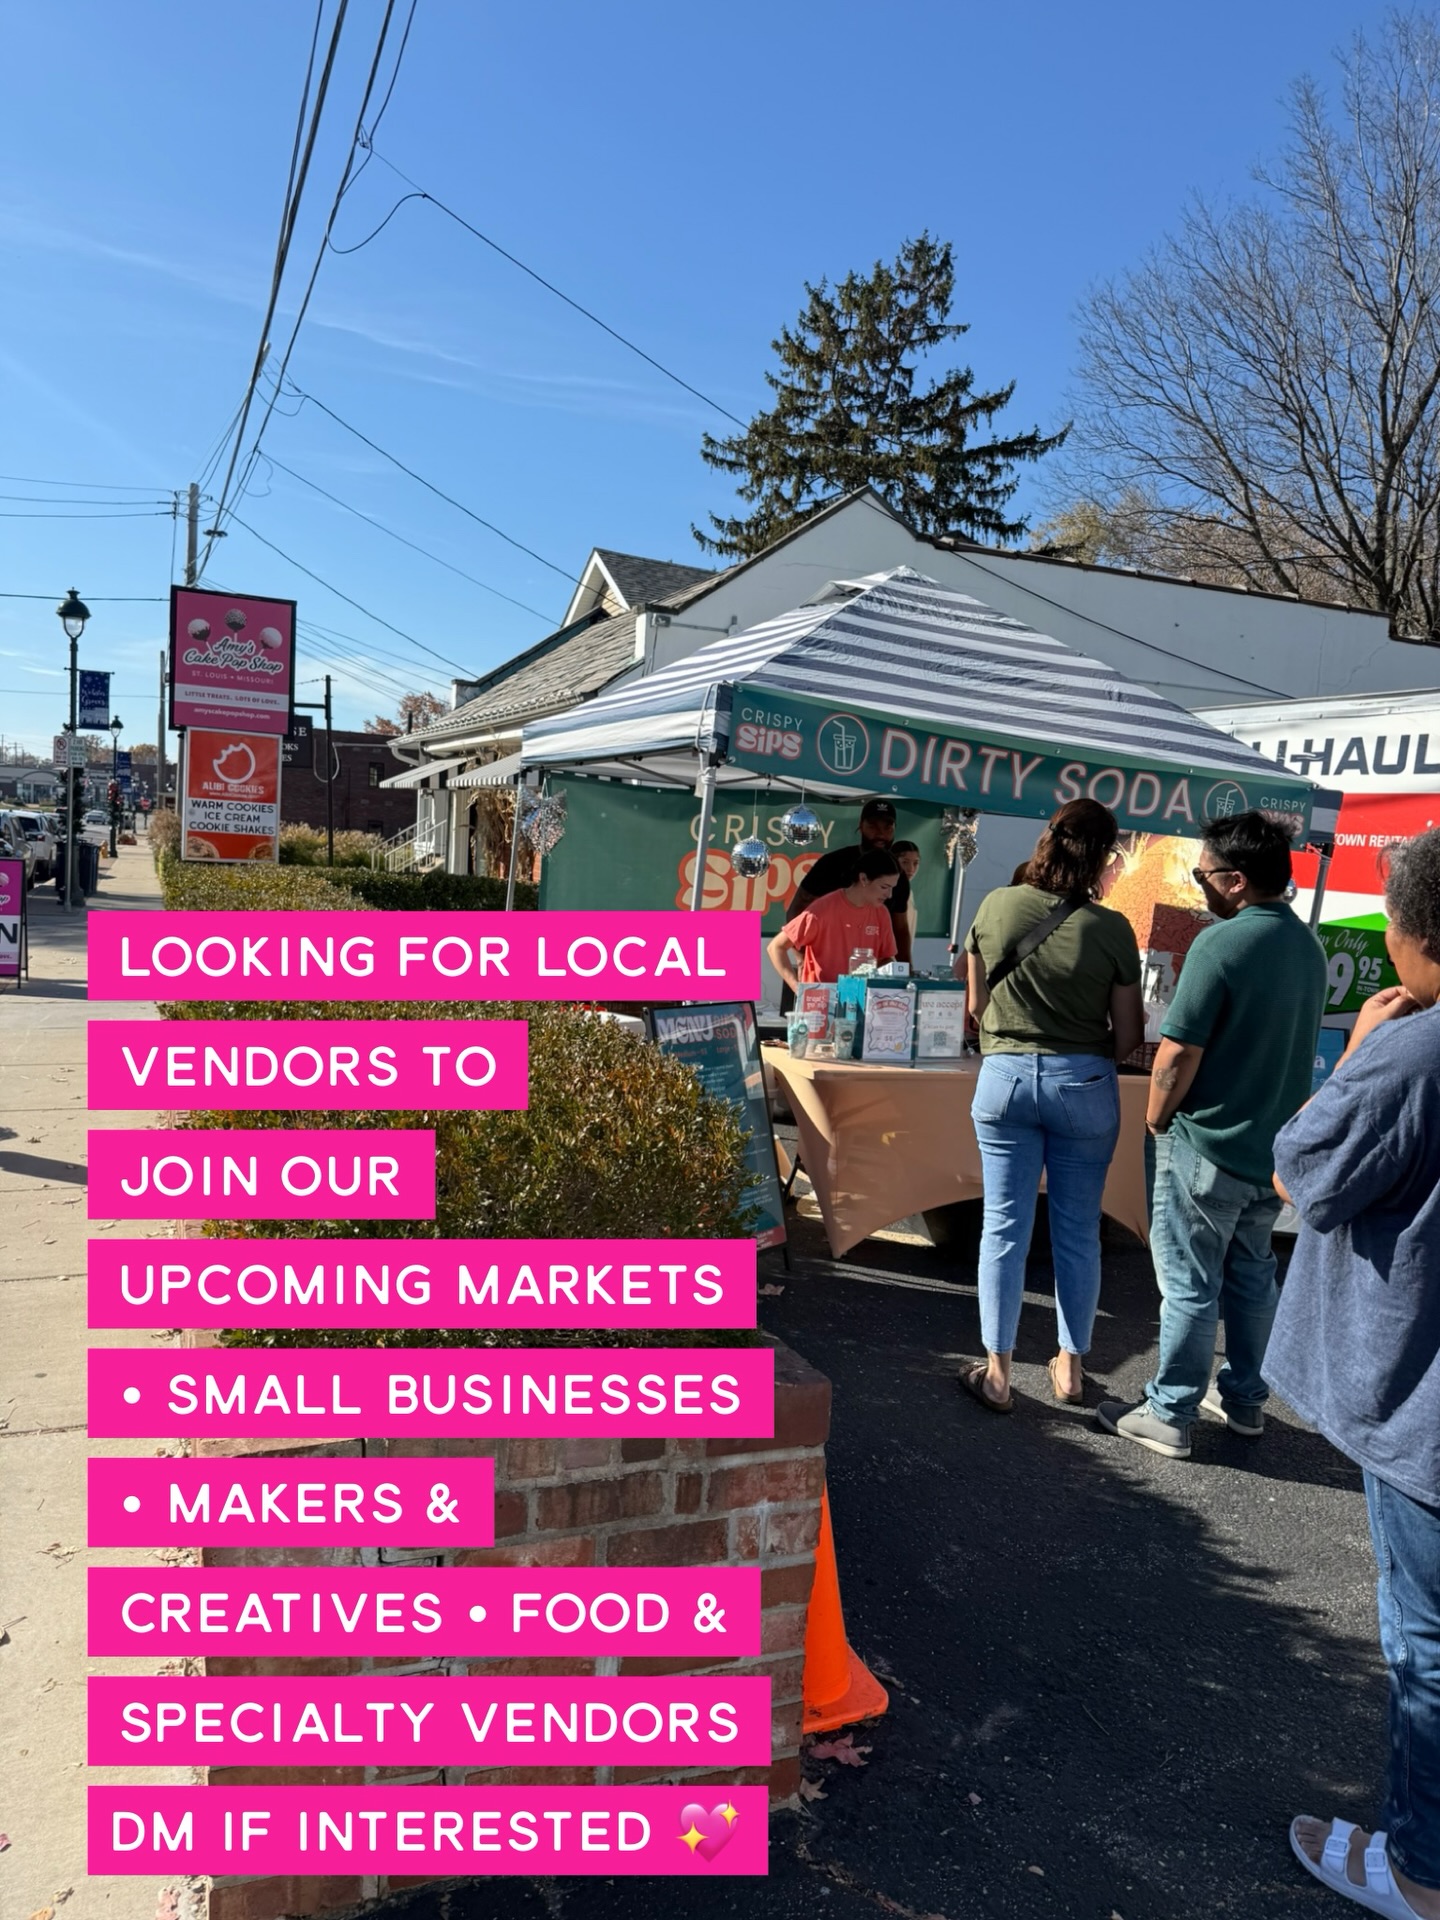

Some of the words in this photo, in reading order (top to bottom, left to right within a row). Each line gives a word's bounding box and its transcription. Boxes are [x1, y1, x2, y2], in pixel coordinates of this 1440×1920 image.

[213, 637, 255, 655] Amy's
[183, 648, 219, 666] Cake
[219, 652, 248, 671] Pop
[249, 655, 284, 675] Shop
[205, 671, 227, 679] LOUIS
[237, 675, 273, 684] MISSOURI
[741, 707, 802, 731] CRISPY
[879, 727, 1043, 800] DIRTY
[1053, 762, 1195, 824] SODA
[202, 781, 225, 791] ALIBI
[227, 783, 264, 794] COOKIES
[191, 799, 224, 810] WARM
[227, 802, 274, 813] COOKIES
[1260, 796, 1306, 812] CRISPY
[204, 811, 221, 820] ICE
[224, 812, 260, 823] CREAM
[189, 821, 230, 832] COOKIE
[233, 824, 274, 835] SHAKES
[690, 814, 835, 848] CRISY
[1334, 929, 1369, 957] Only
[1358, 956, 1383, 981] 95
[716, 1027, 737, 1040] SOD
